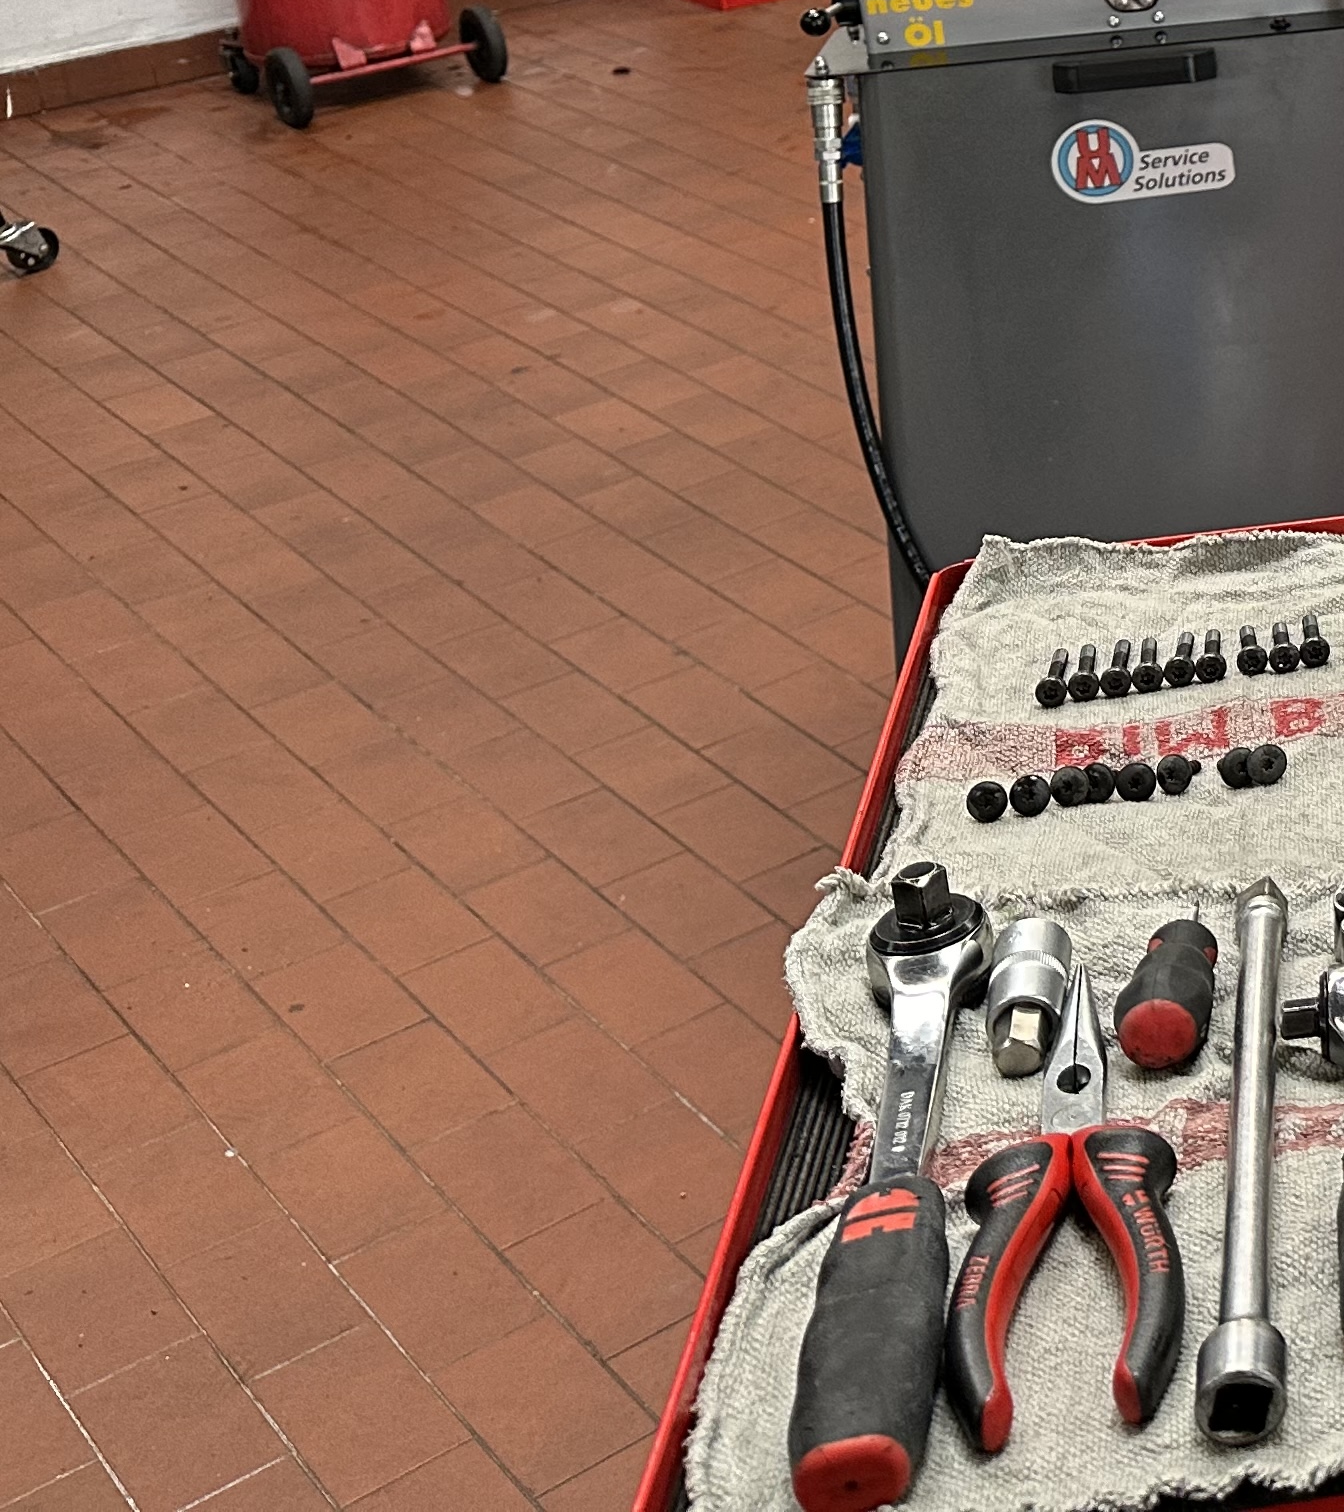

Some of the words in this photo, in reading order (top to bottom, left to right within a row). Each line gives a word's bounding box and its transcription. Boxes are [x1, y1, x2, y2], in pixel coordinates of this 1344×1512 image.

[904, 17, 947, 48] Öl
[1138, 148, 1210, 172] Service
[1133, 164, 1227, 192] Solutions
[1133, 1206, 1171, 1274] WÜRTH
